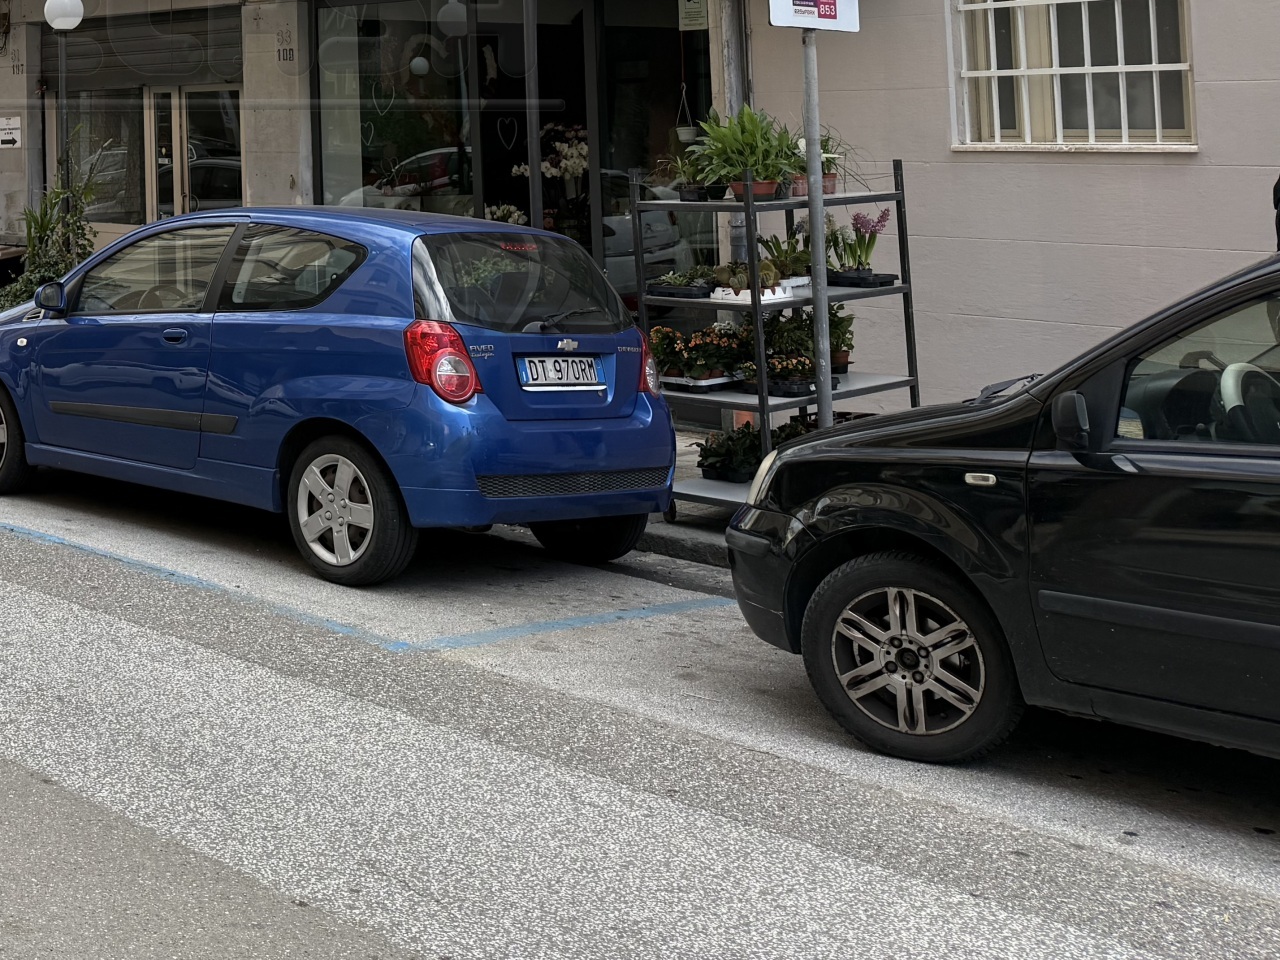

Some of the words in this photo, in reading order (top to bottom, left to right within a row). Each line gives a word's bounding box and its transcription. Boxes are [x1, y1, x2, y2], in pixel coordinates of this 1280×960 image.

[820, 4, 835, 15] 853
[528, 360, 548, 382] DT
[554, 360, 596, 381] 970RM
